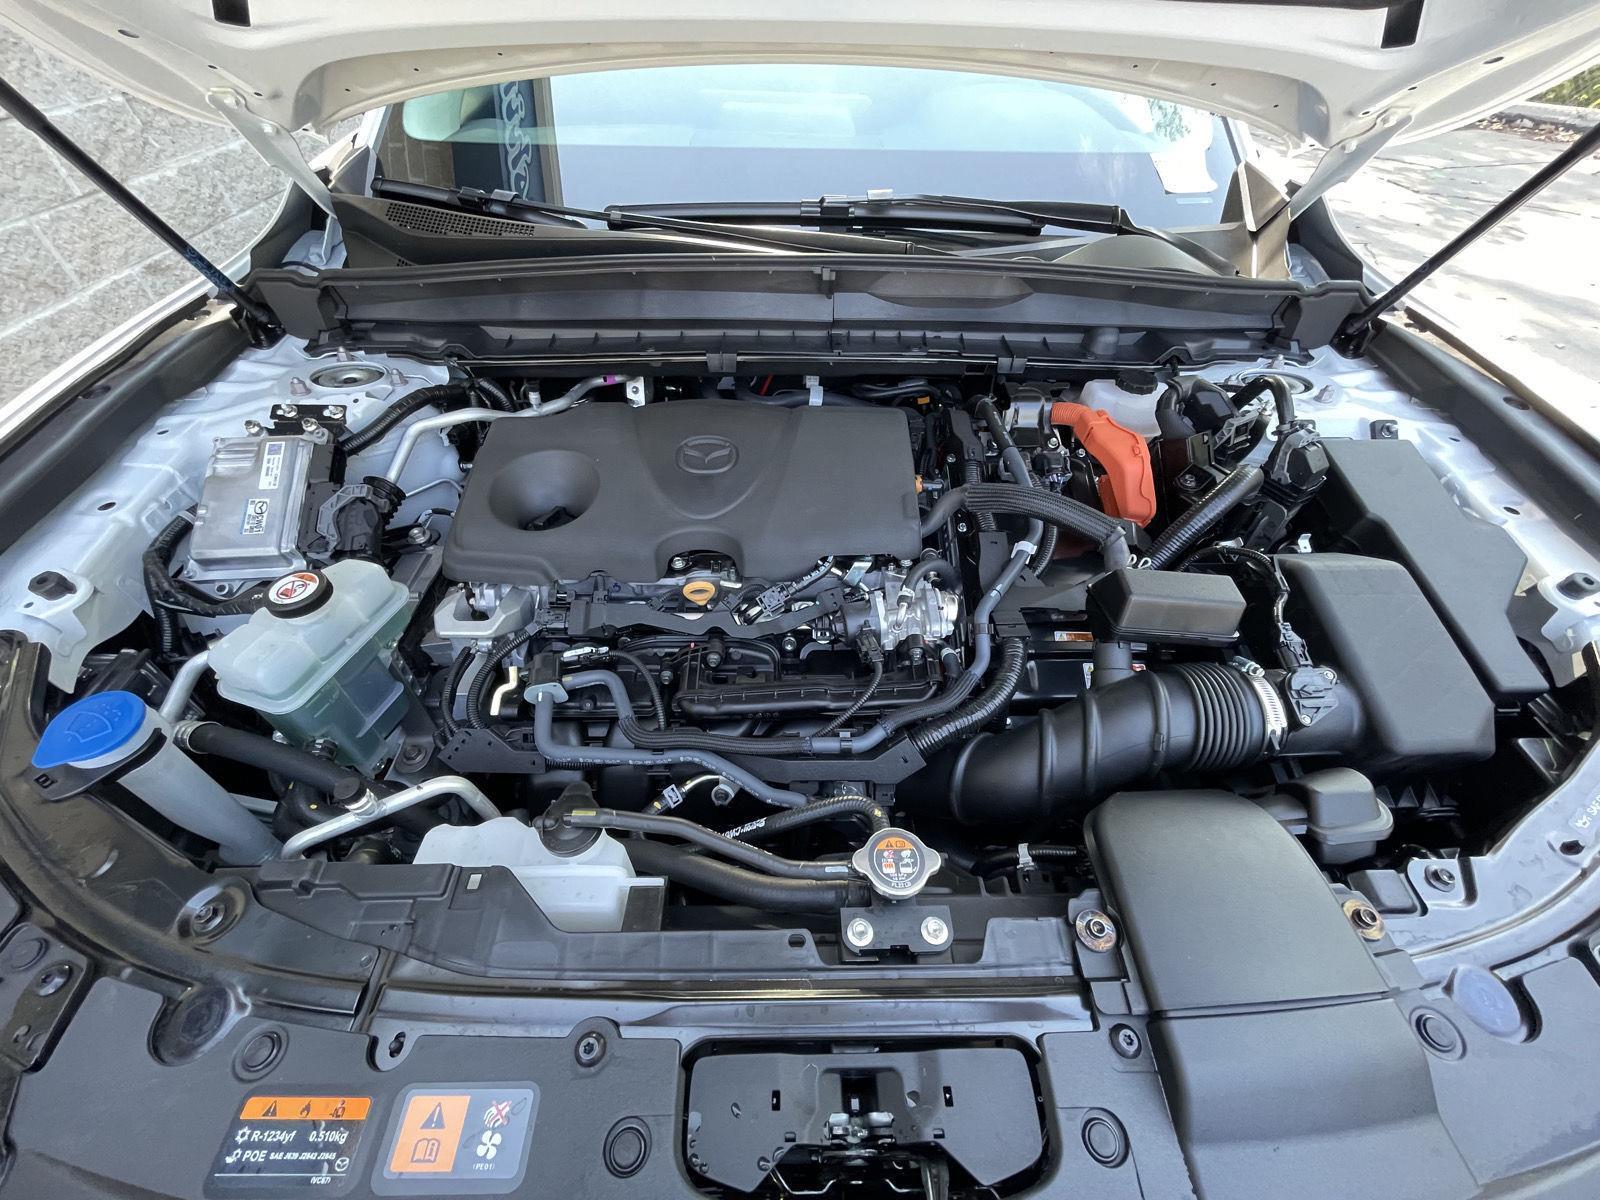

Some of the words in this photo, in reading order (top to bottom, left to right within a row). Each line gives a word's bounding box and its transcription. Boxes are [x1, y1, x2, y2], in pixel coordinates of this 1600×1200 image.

[250, 1130, 296, 1144] R-1234yf
[309, 1130, 348, 1144] 0.510kg
[242, 1150, 268, 1162] POE
[269, 1152, 284, 1160] SAE
